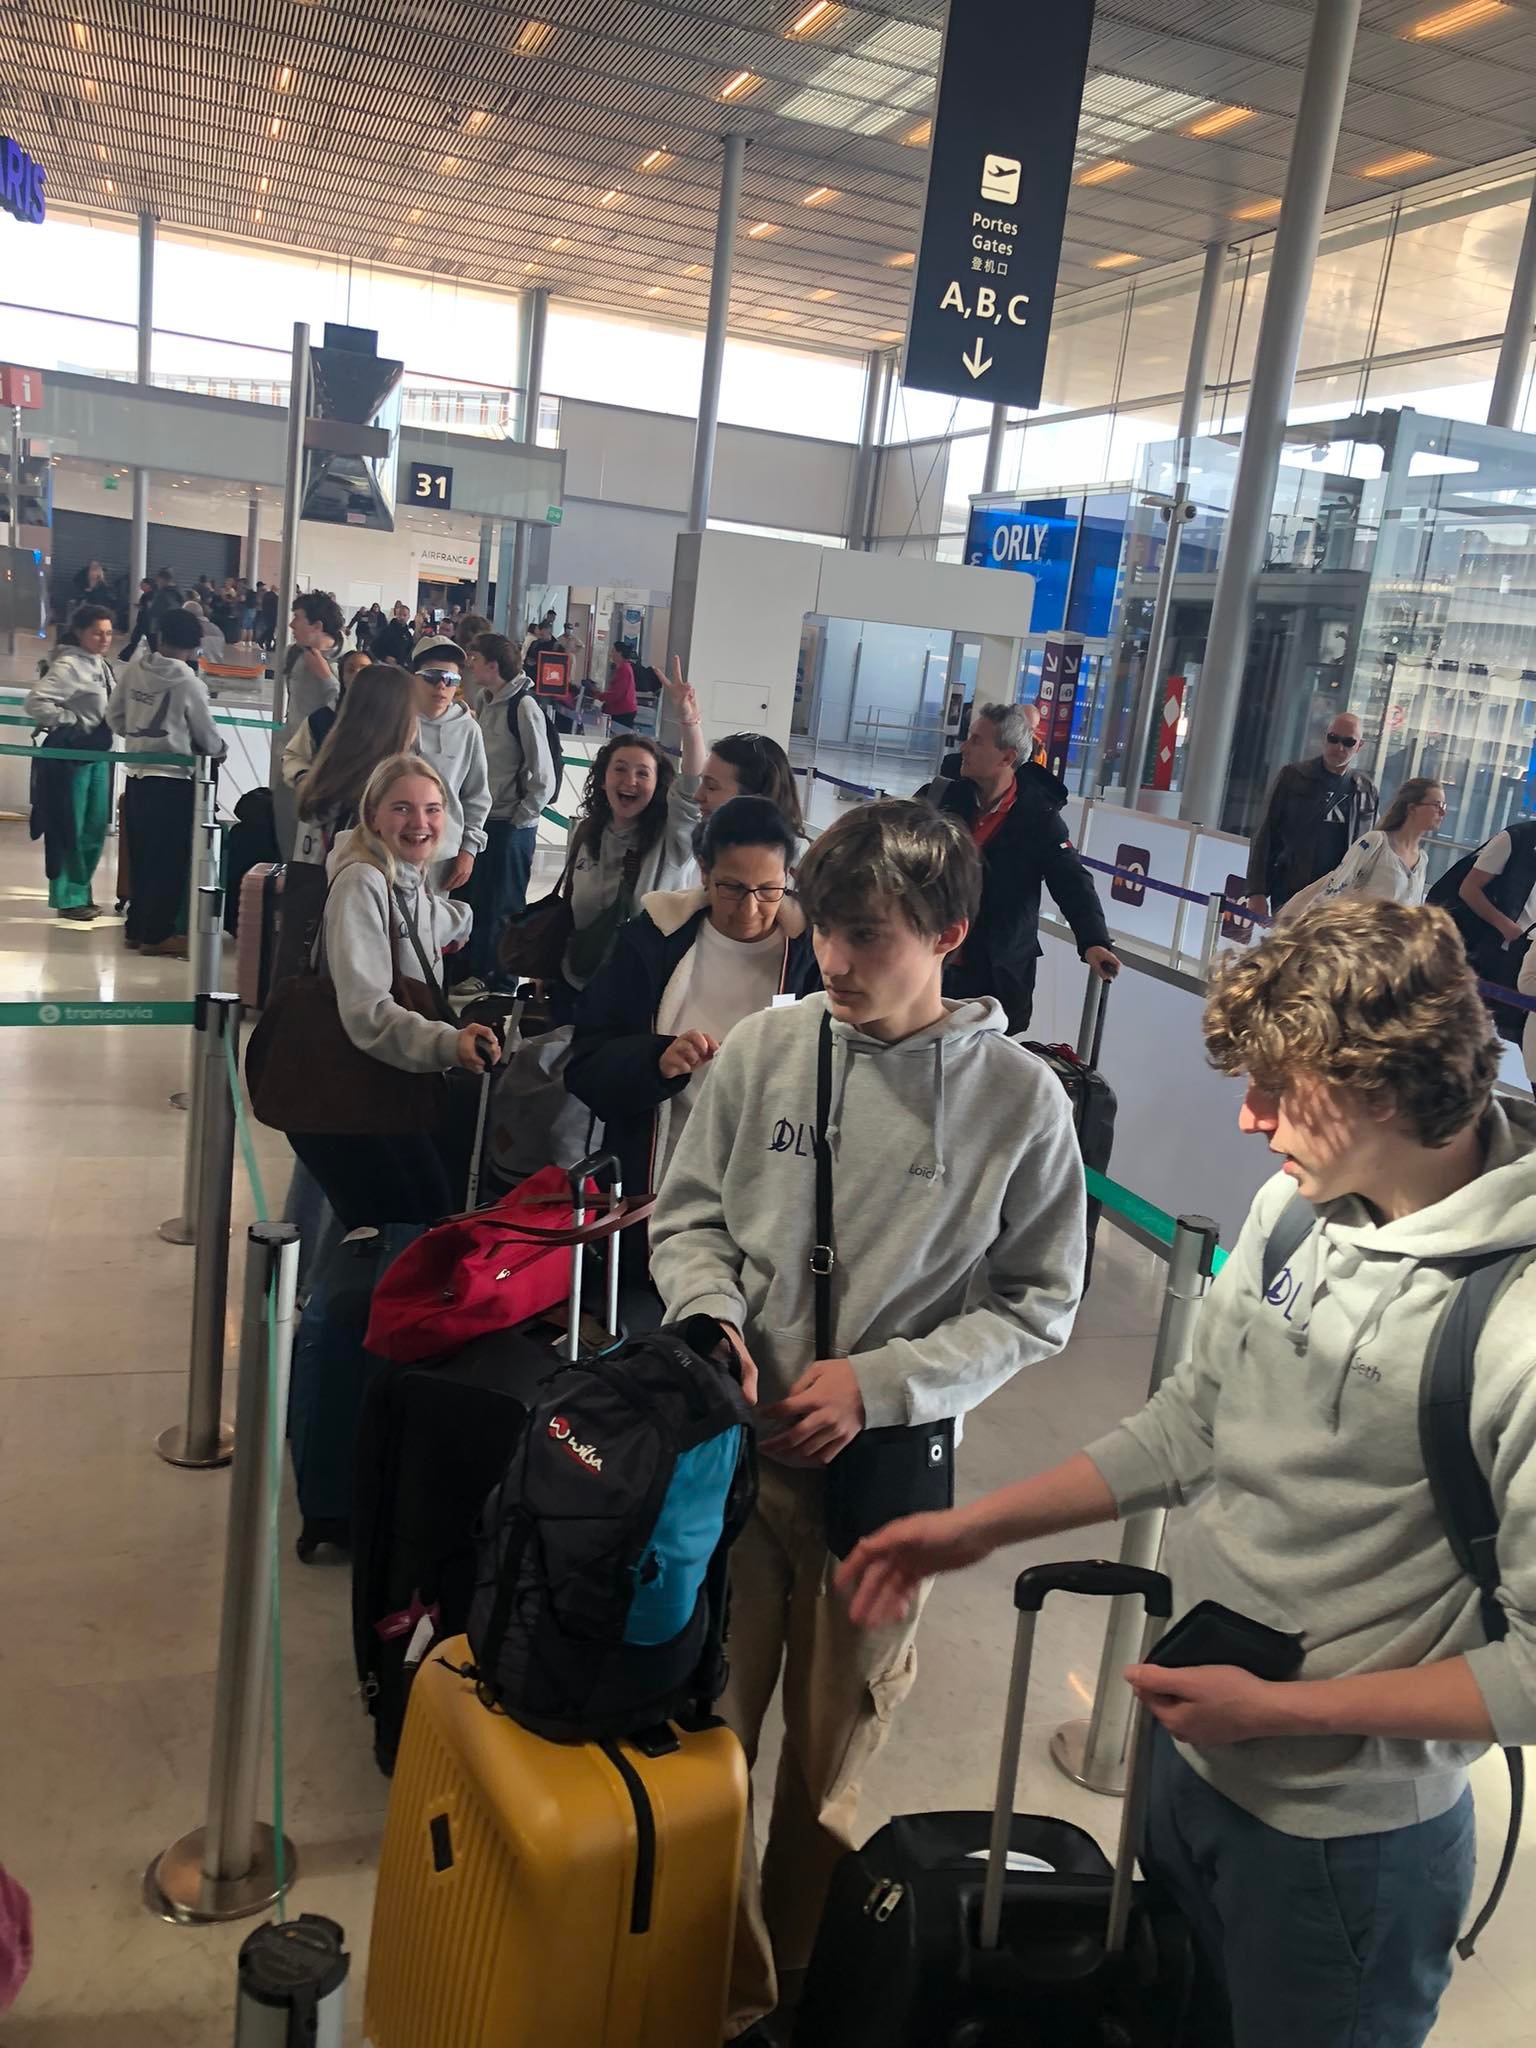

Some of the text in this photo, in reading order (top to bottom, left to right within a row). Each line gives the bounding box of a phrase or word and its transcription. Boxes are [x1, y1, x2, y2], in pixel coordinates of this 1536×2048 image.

[972, 212, 1018, 236] Portes
[972, 234, 1013, 256] Gates
[971, 256, 1008, 276] 登机口
[415, 472, 447, 499] 31
[992, 523, 1049, 562] ORLY
[64, 1006, 153, 1019] transavia
[568, 1436, 604, 1471] wilsa
